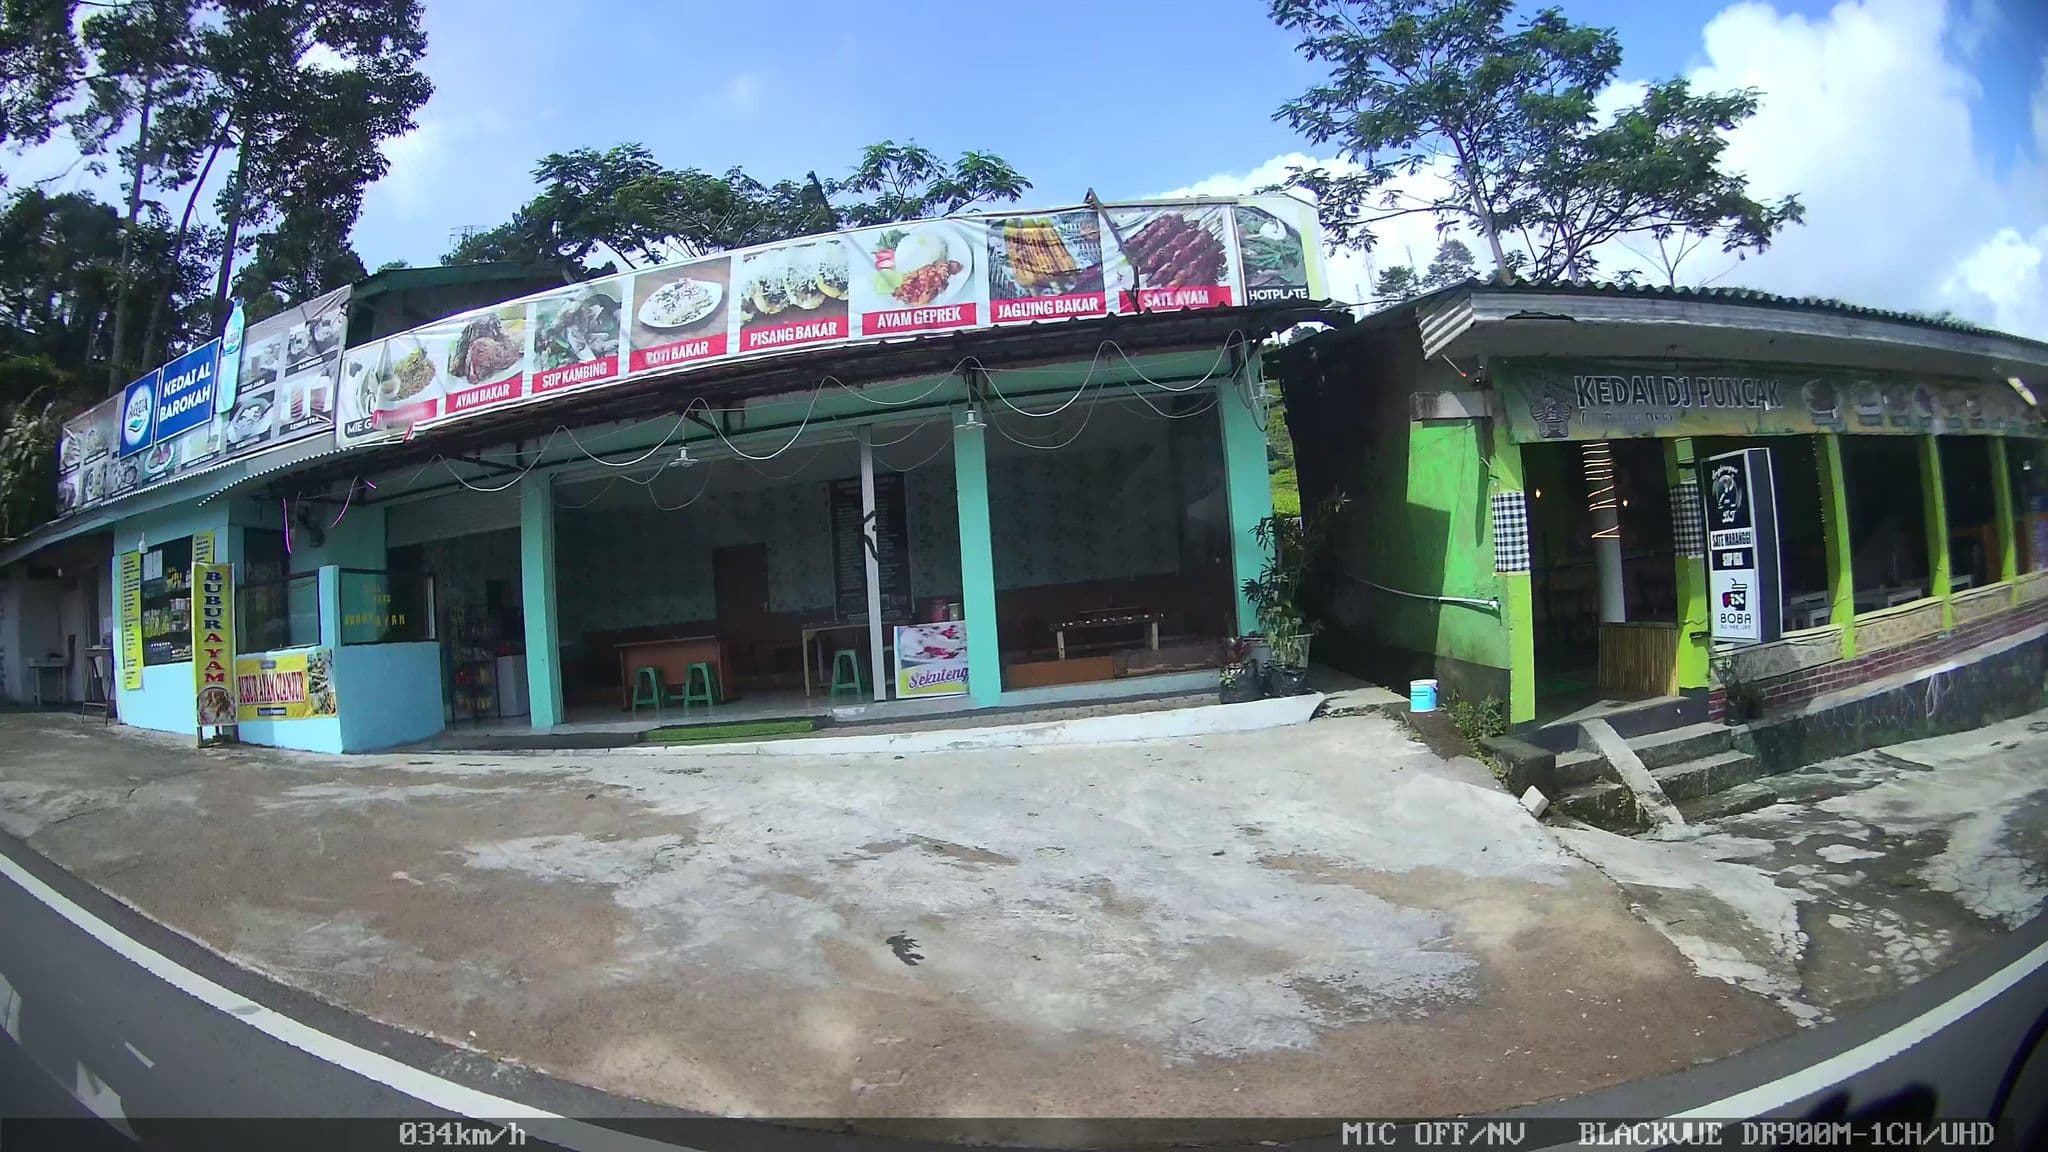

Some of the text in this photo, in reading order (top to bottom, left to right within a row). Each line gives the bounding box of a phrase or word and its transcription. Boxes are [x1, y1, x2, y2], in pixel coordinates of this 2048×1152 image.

[1175, 290, 1209, 306] AYAM
[1249, 288, 1308, 300] HOTPLATE
[1055, 298, 1099, 314] BAKAR
[877, 307, 962, 329] AYAM GEPREK
[750, 321, 838, 346] PISANG BAKAR
[671, 341, 709, 360] BAKAR
[163, 361, 212, 398] KEDAI AL
[542, 361, 608, 388] SOP KAMBING
[159, 384, 212, 423] BAROKAH
[455, 383, 511, 409] AYAM BAKAR
[1573, 375, 1658, 409] KEDAI
[1695, 377, 1783, 410] PUNCAK
[347, 421, 363, 435] MIE
[203, 571, 225, 683] BUBUR AYAM
[1720, 613, 1752, 624] BOBA
